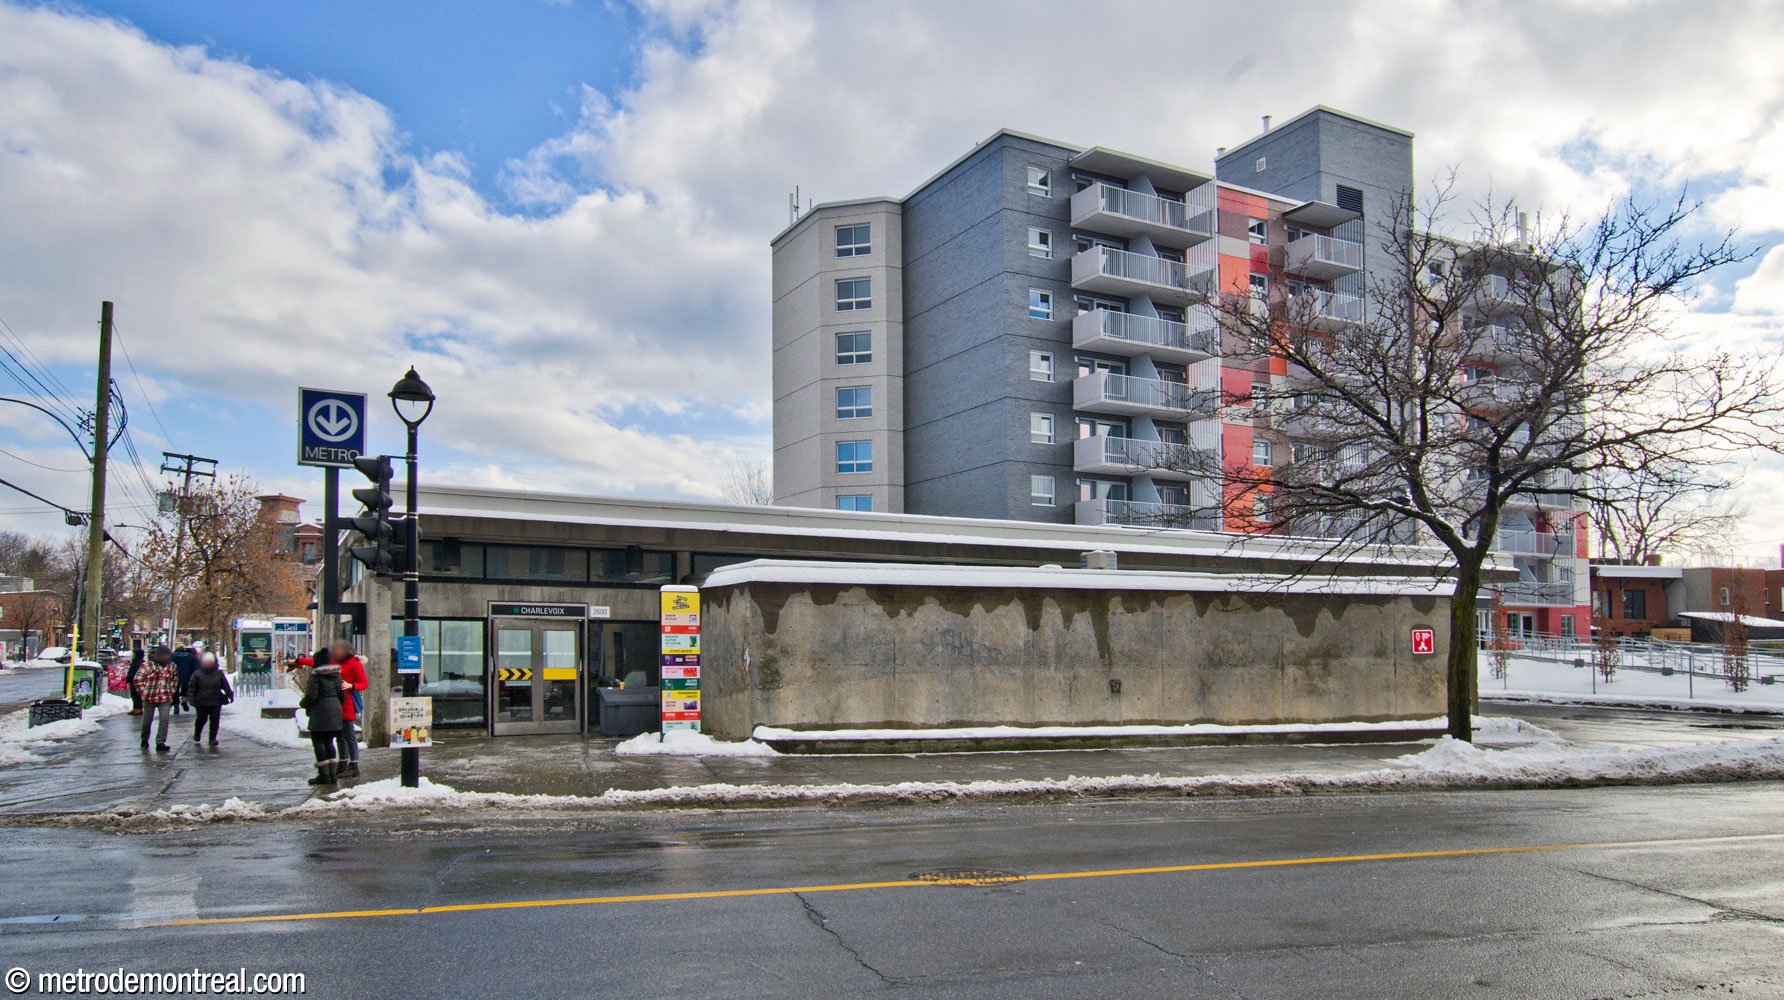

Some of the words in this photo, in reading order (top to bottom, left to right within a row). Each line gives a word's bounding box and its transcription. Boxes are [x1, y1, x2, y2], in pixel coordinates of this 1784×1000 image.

[305, 446, 360, 462] METRO
[521, 606, 565, 615] CHARLEVOIX
[593, 608, 608, 616] 2600
[283, 623, 298, 631] Bell
